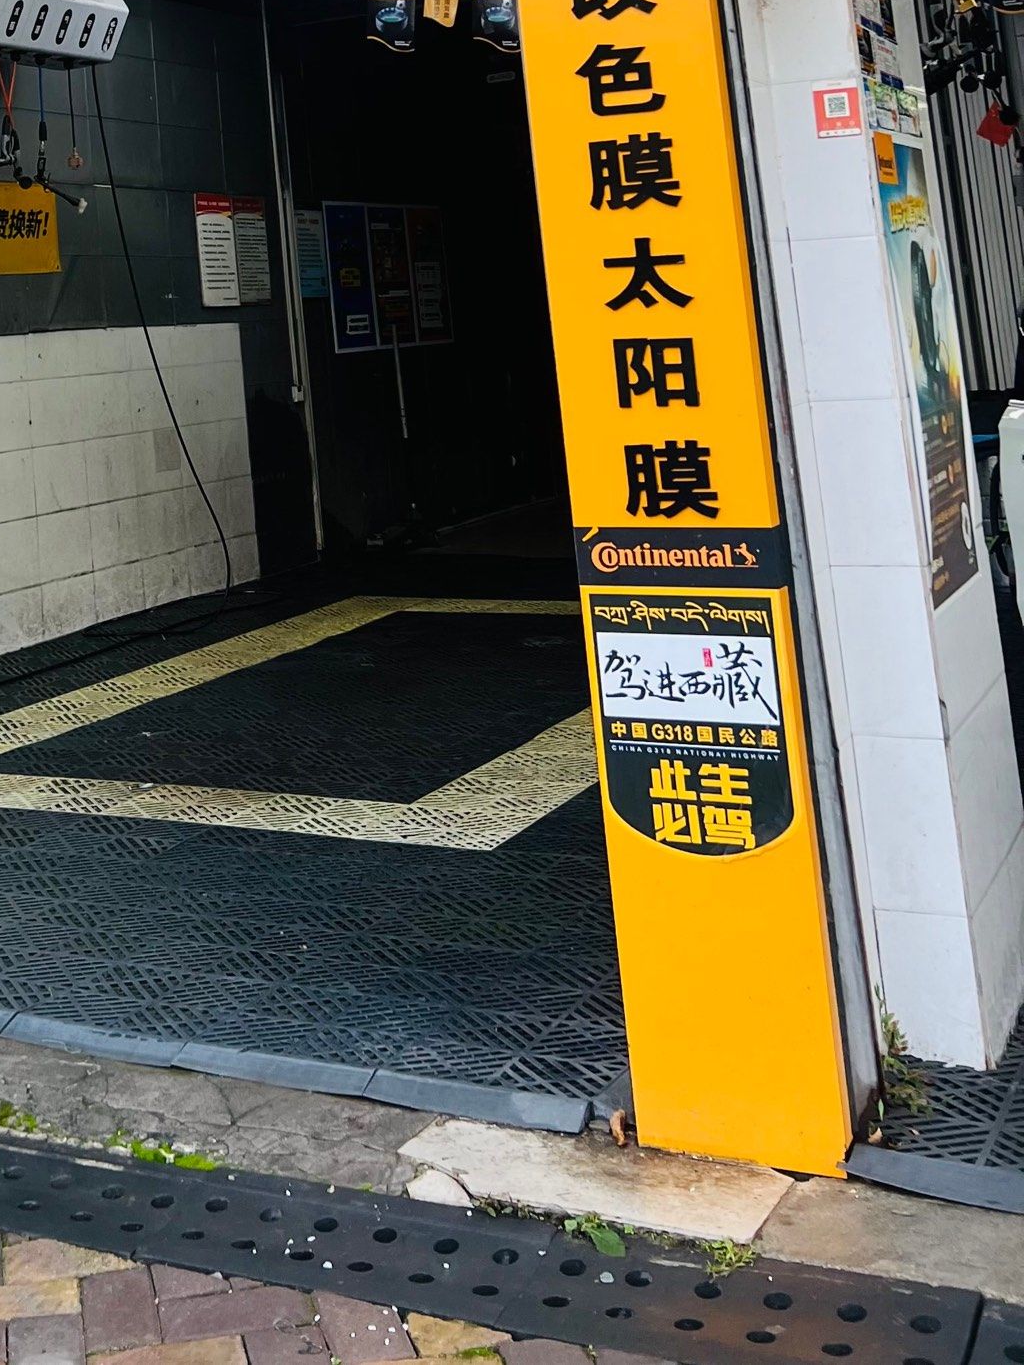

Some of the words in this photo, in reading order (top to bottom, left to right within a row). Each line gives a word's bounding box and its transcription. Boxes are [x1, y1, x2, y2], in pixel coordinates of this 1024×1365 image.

[589, 540, 735, 573] Continental
[611, 745, 643, 753] CHINA
[647, 747, 672, 755] G318
[730, 752, 780, 762] HIGHWAY
[648, 758, 753, 805] 此生
[651, 802, 757, 851] 必驾
